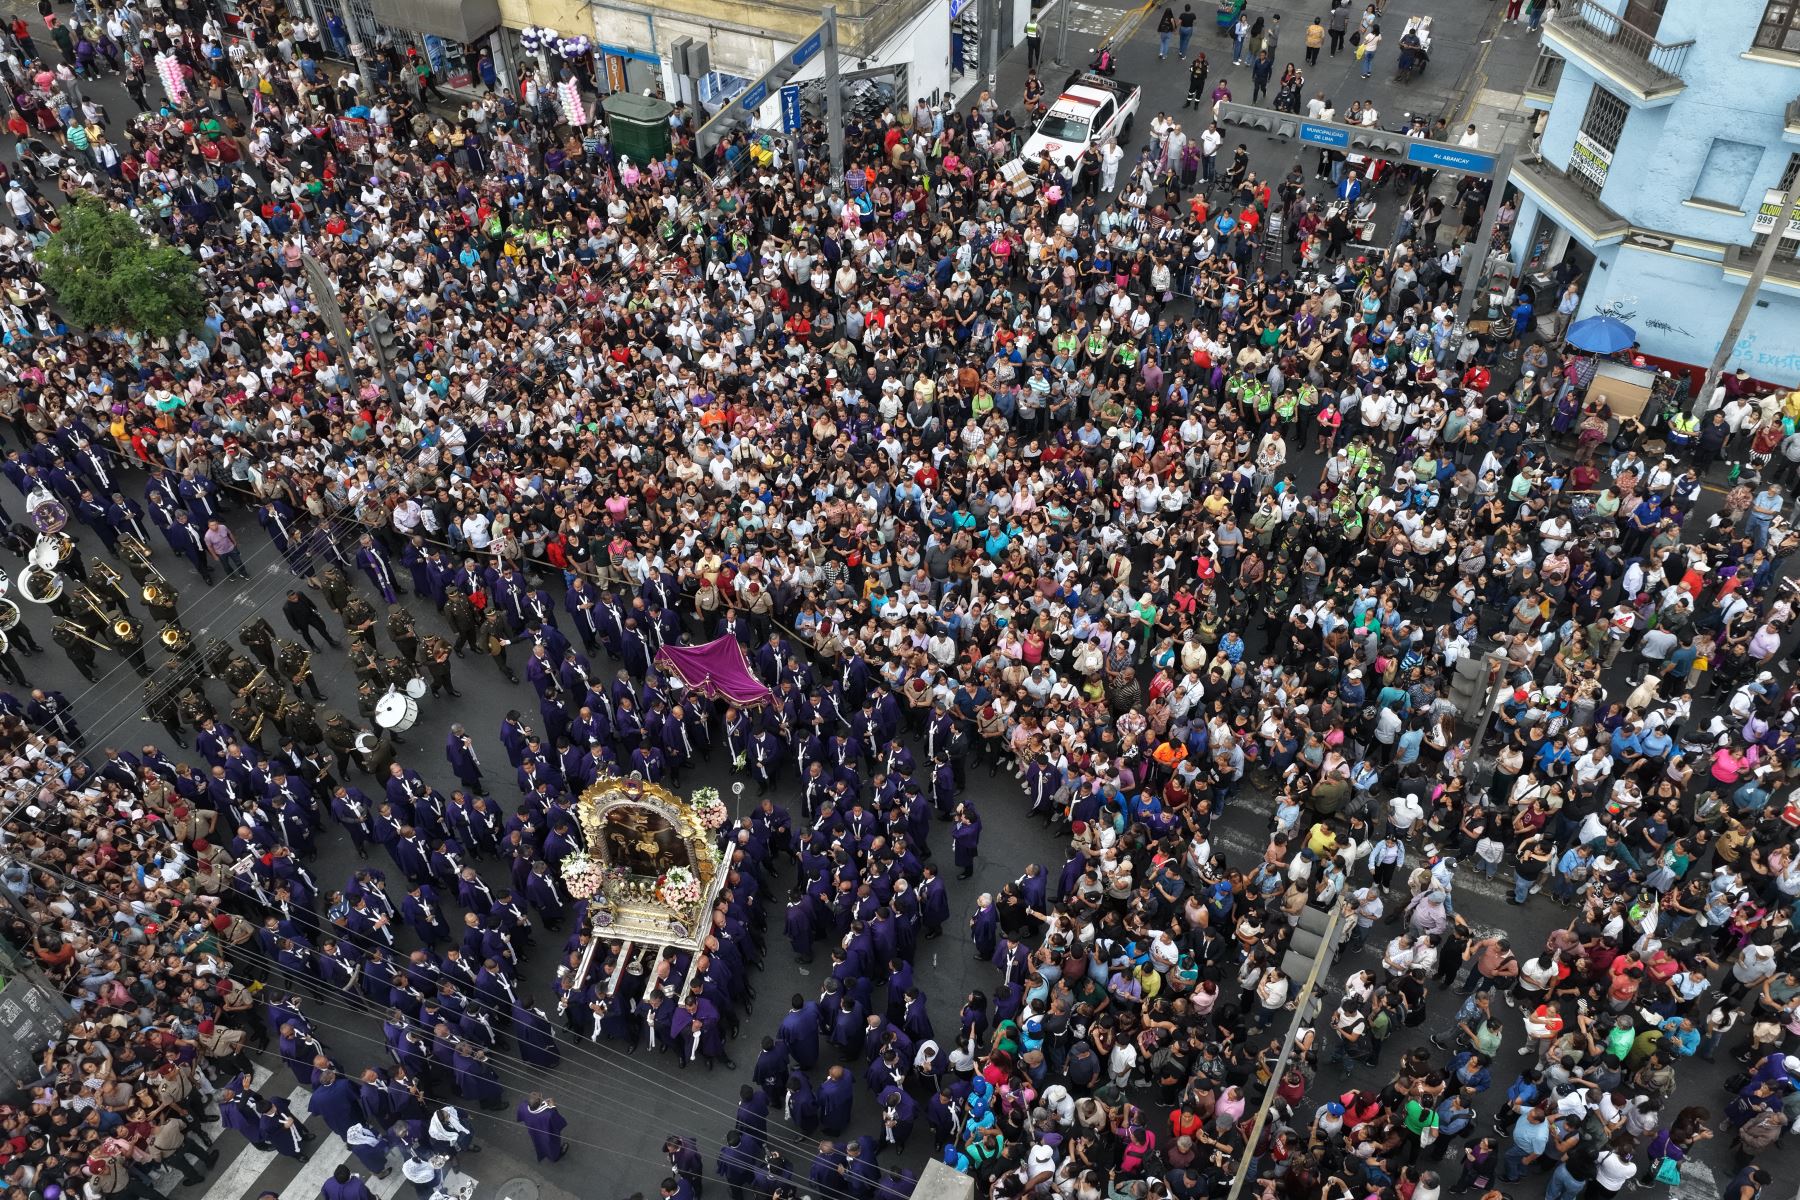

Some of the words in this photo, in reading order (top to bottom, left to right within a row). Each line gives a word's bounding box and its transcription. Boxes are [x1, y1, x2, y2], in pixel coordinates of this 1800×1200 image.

[610, 57, 621, 91] BOTIC
[786, 96, 795, 126] VENTA
[1049, 110, 1090, 124] RESCATE
[1306, 127, 1344, 138] MUNICIPALIDAD
[1442, 155, 1470, 165] ABANCAY
[1757, 215, 1773, 224] 999
